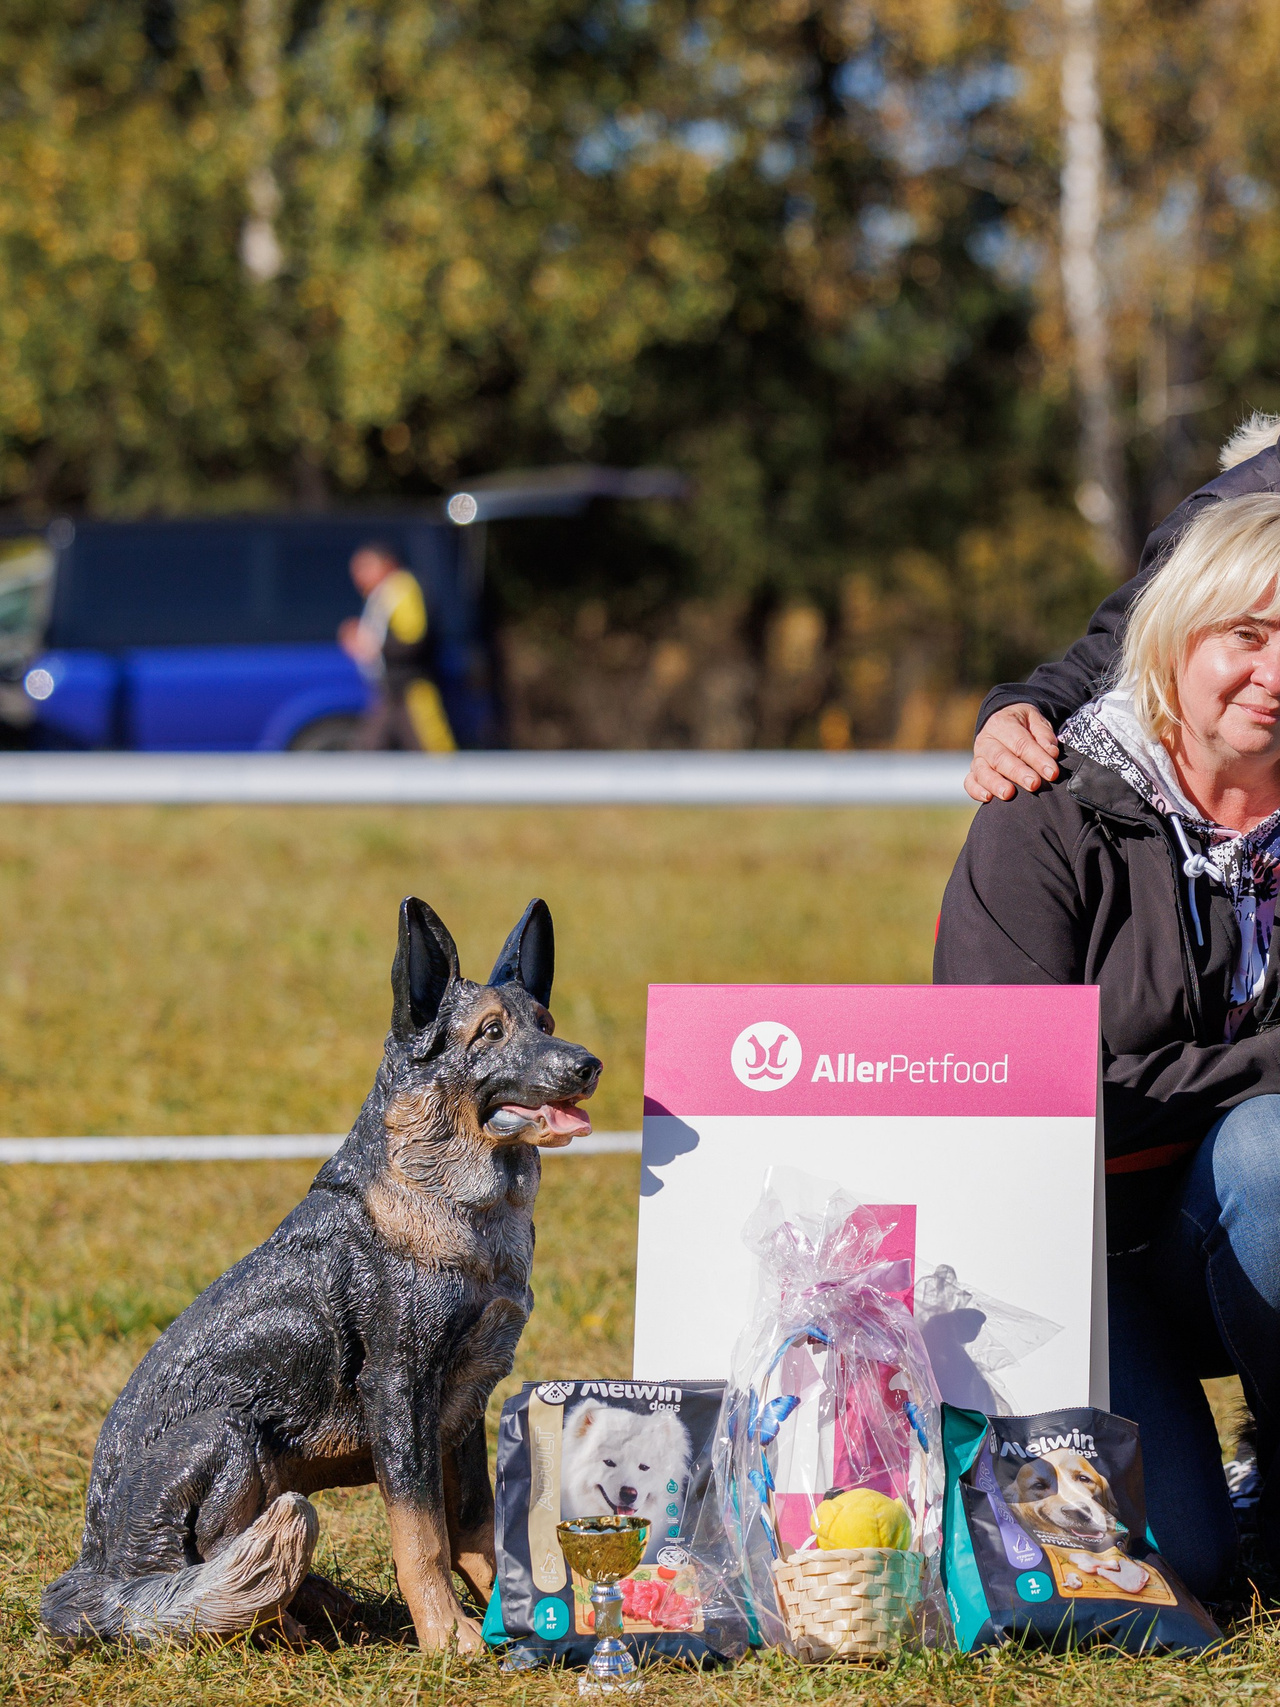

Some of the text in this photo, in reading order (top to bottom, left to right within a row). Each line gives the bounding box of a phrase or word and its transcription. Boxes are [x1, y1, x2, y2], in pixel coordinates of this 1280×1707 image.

[811, 1053, 1009, 1084] AllerPetfood
[649, 1400, 681, 1413] dogs
[1000, 1428, 1096, 1459] Melwin
[1068, 1446, 1099, 1459] dogs
[535, 1426, 556, 1511] ADULT
[1027, 1577, 1040, 1589] 1
[545, 1606, 557, 1622] 1
